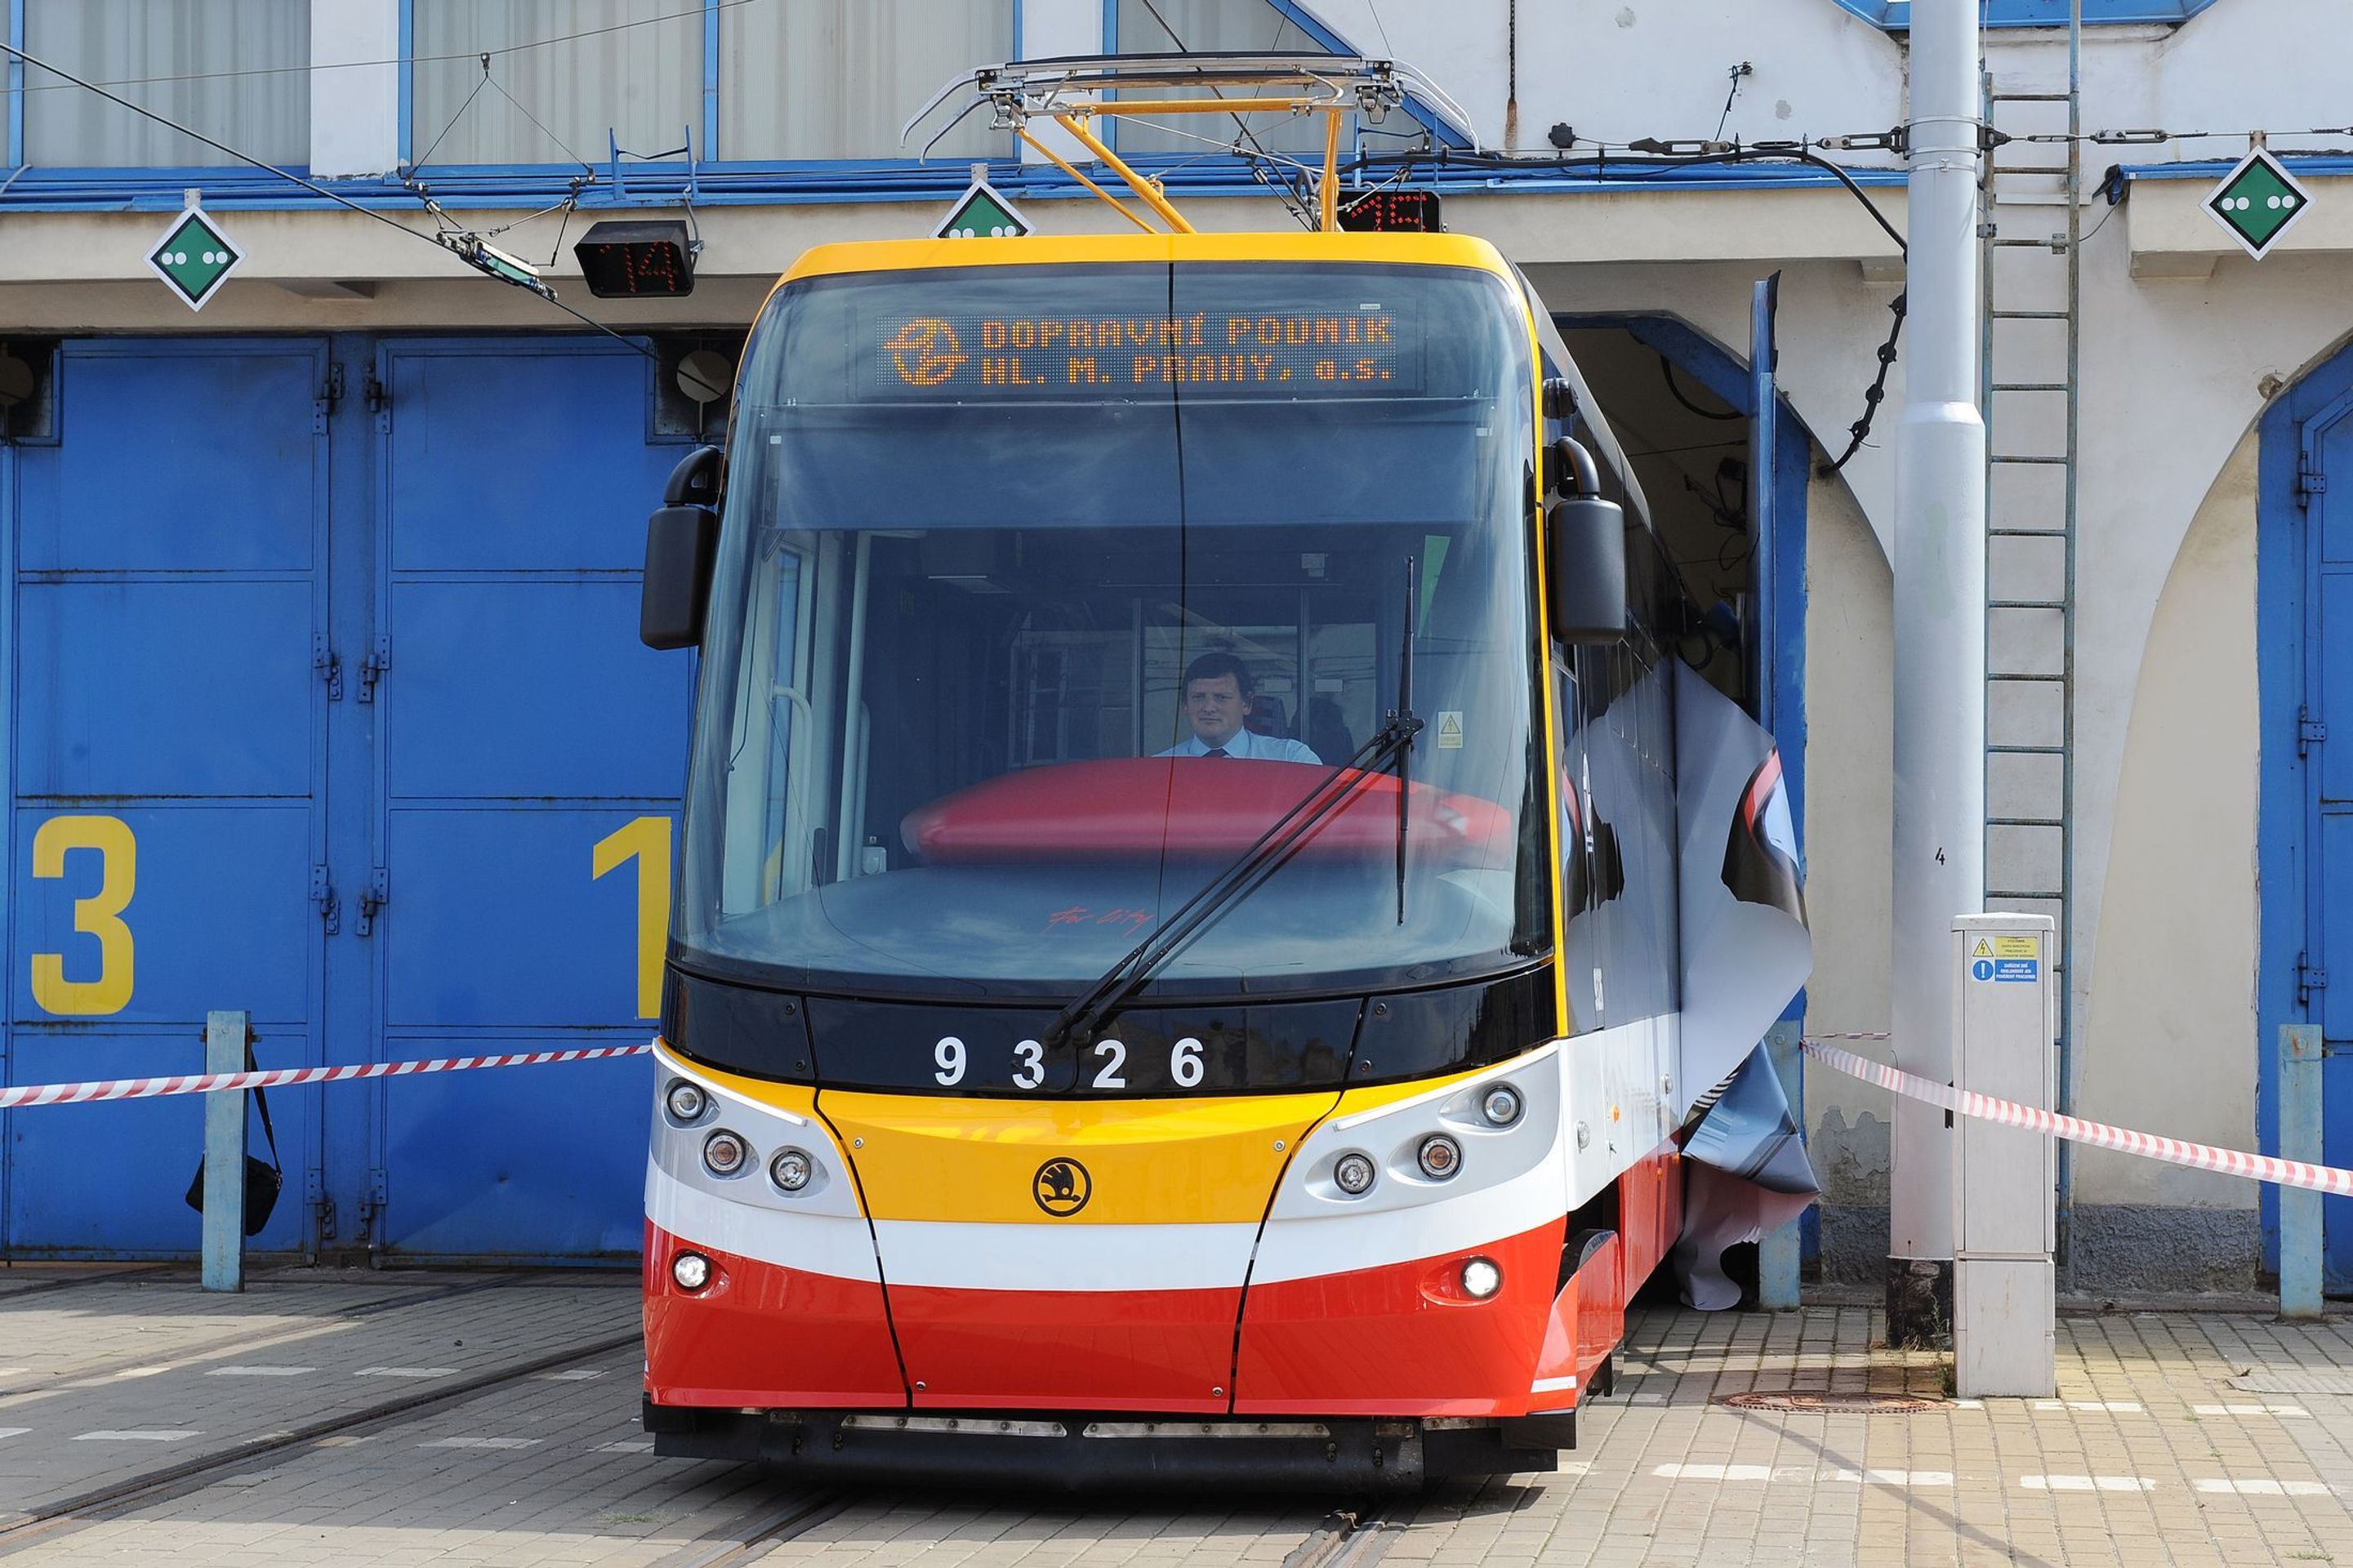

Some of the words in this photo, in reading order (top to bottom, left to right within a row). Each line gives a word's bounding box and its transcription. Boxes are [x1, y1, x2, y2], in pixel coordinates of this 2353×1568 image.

[982, 311, 1204, 348] DOPRAVNÍ
[1228, 316, 1390, 344] PODNIK
[983, 356, 1046, 385] HL.
[1067, 354, 1112, 384] M.
[1133, 353, 1292, 382] PRAHY,
[1315, 359, 1391, 381] a.s.
[32, 815, 136, 1015] 3
[592, 816, 671, 1019] 1
